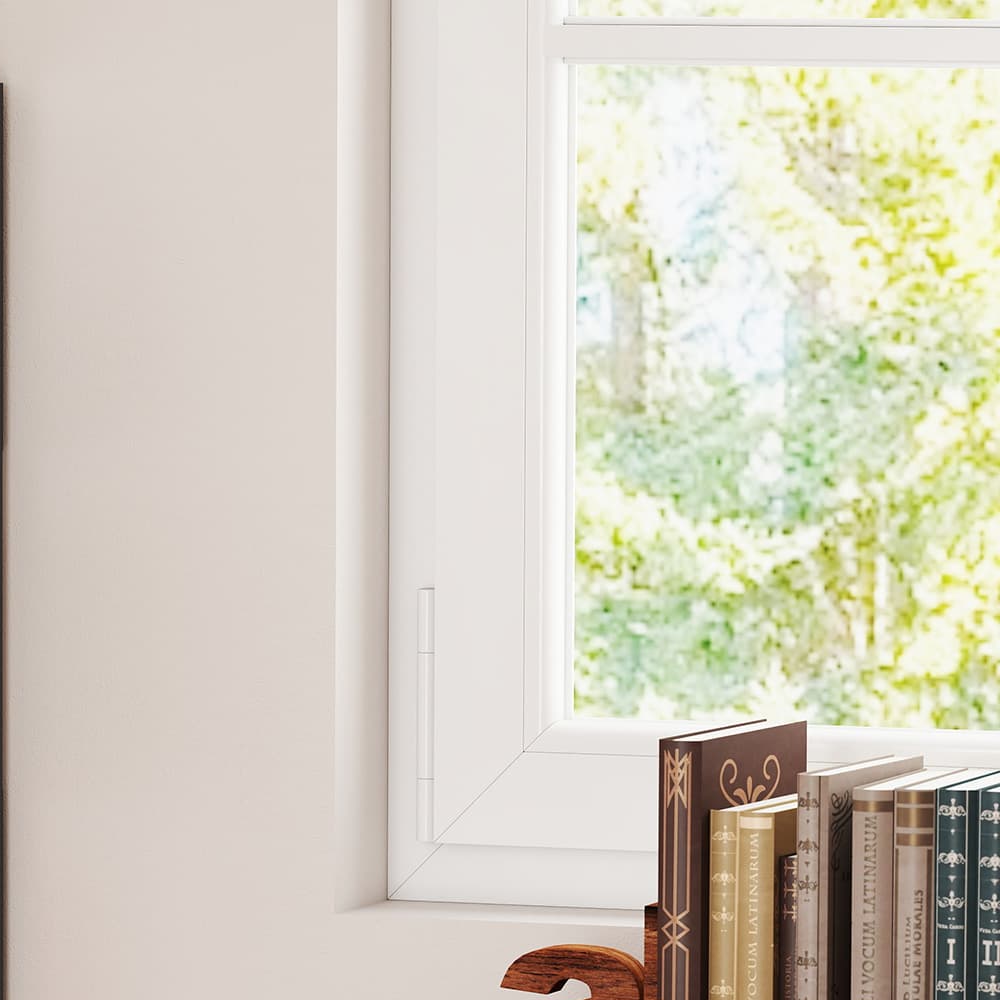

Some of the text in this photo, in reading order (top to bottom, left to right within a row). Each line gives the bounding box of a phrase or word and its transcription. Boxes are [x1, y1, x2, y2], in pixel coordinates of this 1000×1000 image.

[748, 832, 760, 936] LATINARUM
[863, 815, 878, 915] LATINARUM
[862, 919, 876, 985] VOCUM
